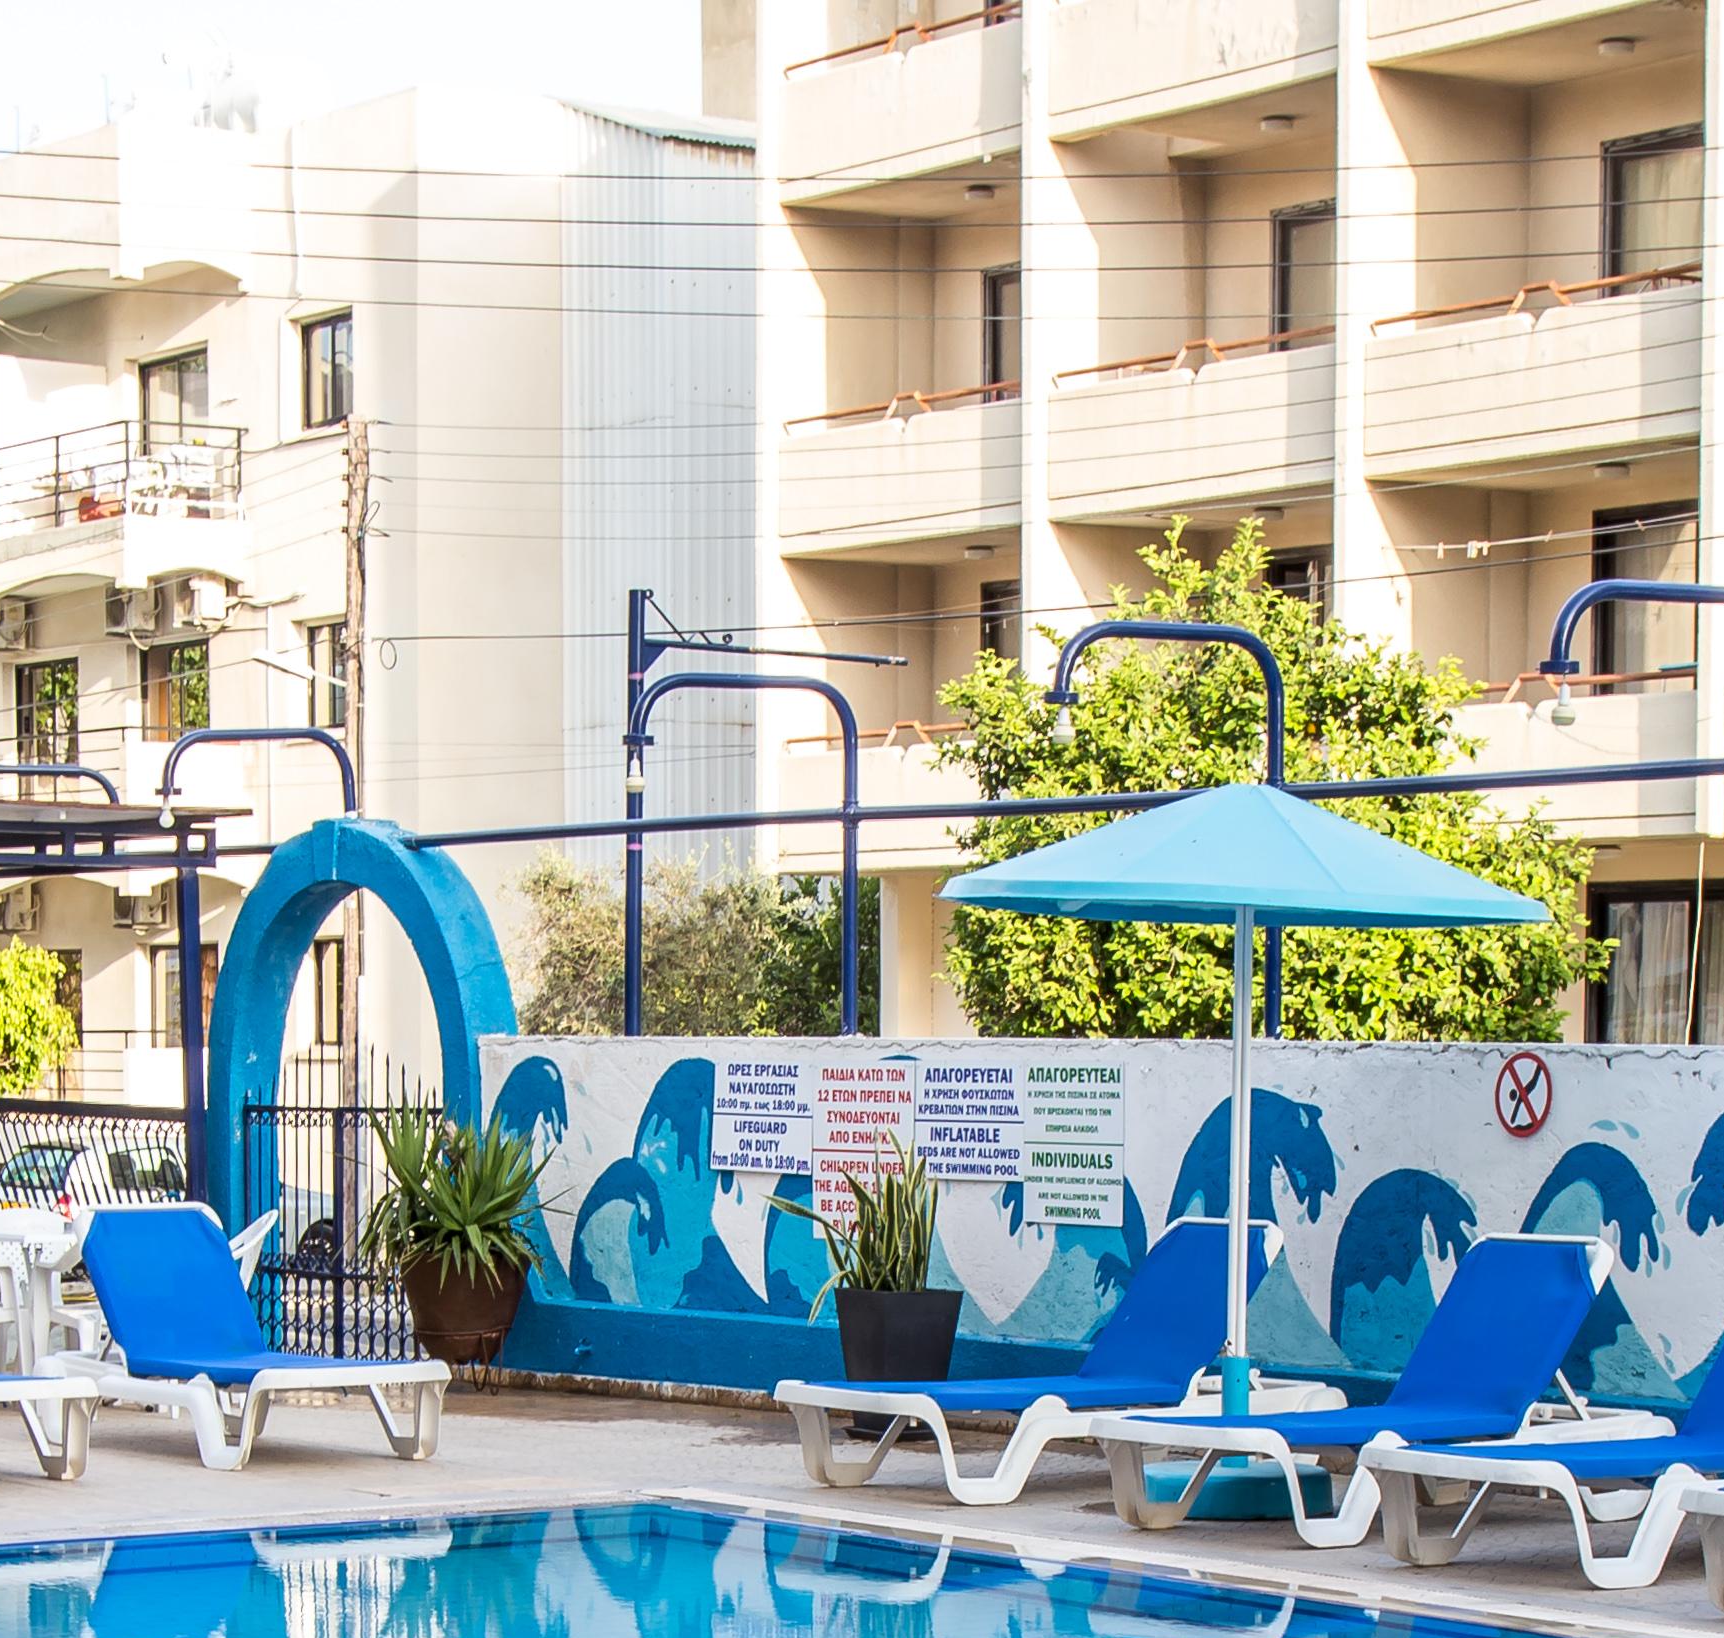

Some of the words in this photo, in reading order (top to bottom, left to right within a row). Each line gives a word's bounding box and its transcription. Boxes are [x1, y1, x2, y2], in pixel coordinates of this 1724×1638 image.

[728, 1064, 752, 1076] ΩΡΕΣ
[755, 1064, 799, 1077] ΕΡΓΑΣΙΑΣ
[822, 1069, 855, 1081] ΠΑΙΔΙΑ
[858, 1069, 883, 1082] ΚΑΤΩ
[886, 1069, 905, 1082] ΤΩΝ
[925, 1068, 1012, 1083] ΑΠΑΓΟΡΕΥΕΤΑΙ
[1027, 1067, 1121, 1083] ΑΠΑΓΟΡΕΥΤΕΑΙ
[729, 1082, 795, 1095] ΝΑΥΑΓΟΣΩΣΤΗ
[924, 1089, 930, 1099] Η
[931, 1089, 959, 1099] ΧΡΗΣΗ
[962, 1089, 1014, 1100] ΦΟΥΣΚΩΤΩΝ
[818, 1089, 829, 1102] 12
[832, 1090, 857, 1102] ΕΤΩΝ
[860, 1090, 895, 1103] ΠΡΕΠΕΙ
[898, 1090, 912, 1104] ΝΑ
[717, 1097, 738, 1108] 10:00
[772, 1099, 795, 1111] 18:00
[918, 1104, 964, 1115] ΚΡΕΒΑΤΙΩΝ
[966, 1105, 987, 1116] ΣΤΗΝ
[990, 1105, 1019, 1116] ΠΙΣΙΝΑ
[827, 1110, 900, 1124] ΣΥΝΟΔΕΥΟΝΤΑΙ
[734, 1120, 787, 1134] LIFEGUARD
[829, 1131, 849, 1143] ΑΠΟ
[930, 1127, 1000, 1143] INFLATABLE
[739, 1139, 752, 1151] ON
[755, 1139, 780, 1152] DUTY
[712, 1150, 728, 1165] from
[730, 1152, 749, 1167] 10:00
[765, 1155, 773, 1168] to
[775, 1155, 795, 1170] 18:00
[917, 1146, 938, 1157] BEDS
[940, 1147, 957, 1158] ARE
[959, 1147, 975, 1158] NOT
[978, 1148, 1020, 1160] ALLOWED
[1032, 1152, 1113, 1169] INDIVIDUALS
[929, 1162, 943, 1173] THE
[945, 1163, 991, 1175] SWIMMING
[994, 1164, 1019, 1176] POOL
[814, 1179, 832, 1192] THE
[1055, 1176, 1086, 1184] INFLUENCE
[1088, 1177, 1095, 1185] OF
[1038, 1192, 1049, 1200] ARE
[1062, 1193, 1089, 1201] ALLOWED
[1098, 1194, 1109, 1202] THE
[821, 1199, 833, 1212] BE
[1045, 1206, 1081, 1219] SWIMMING
[1082, 1207, 1101, 1220] POOL
